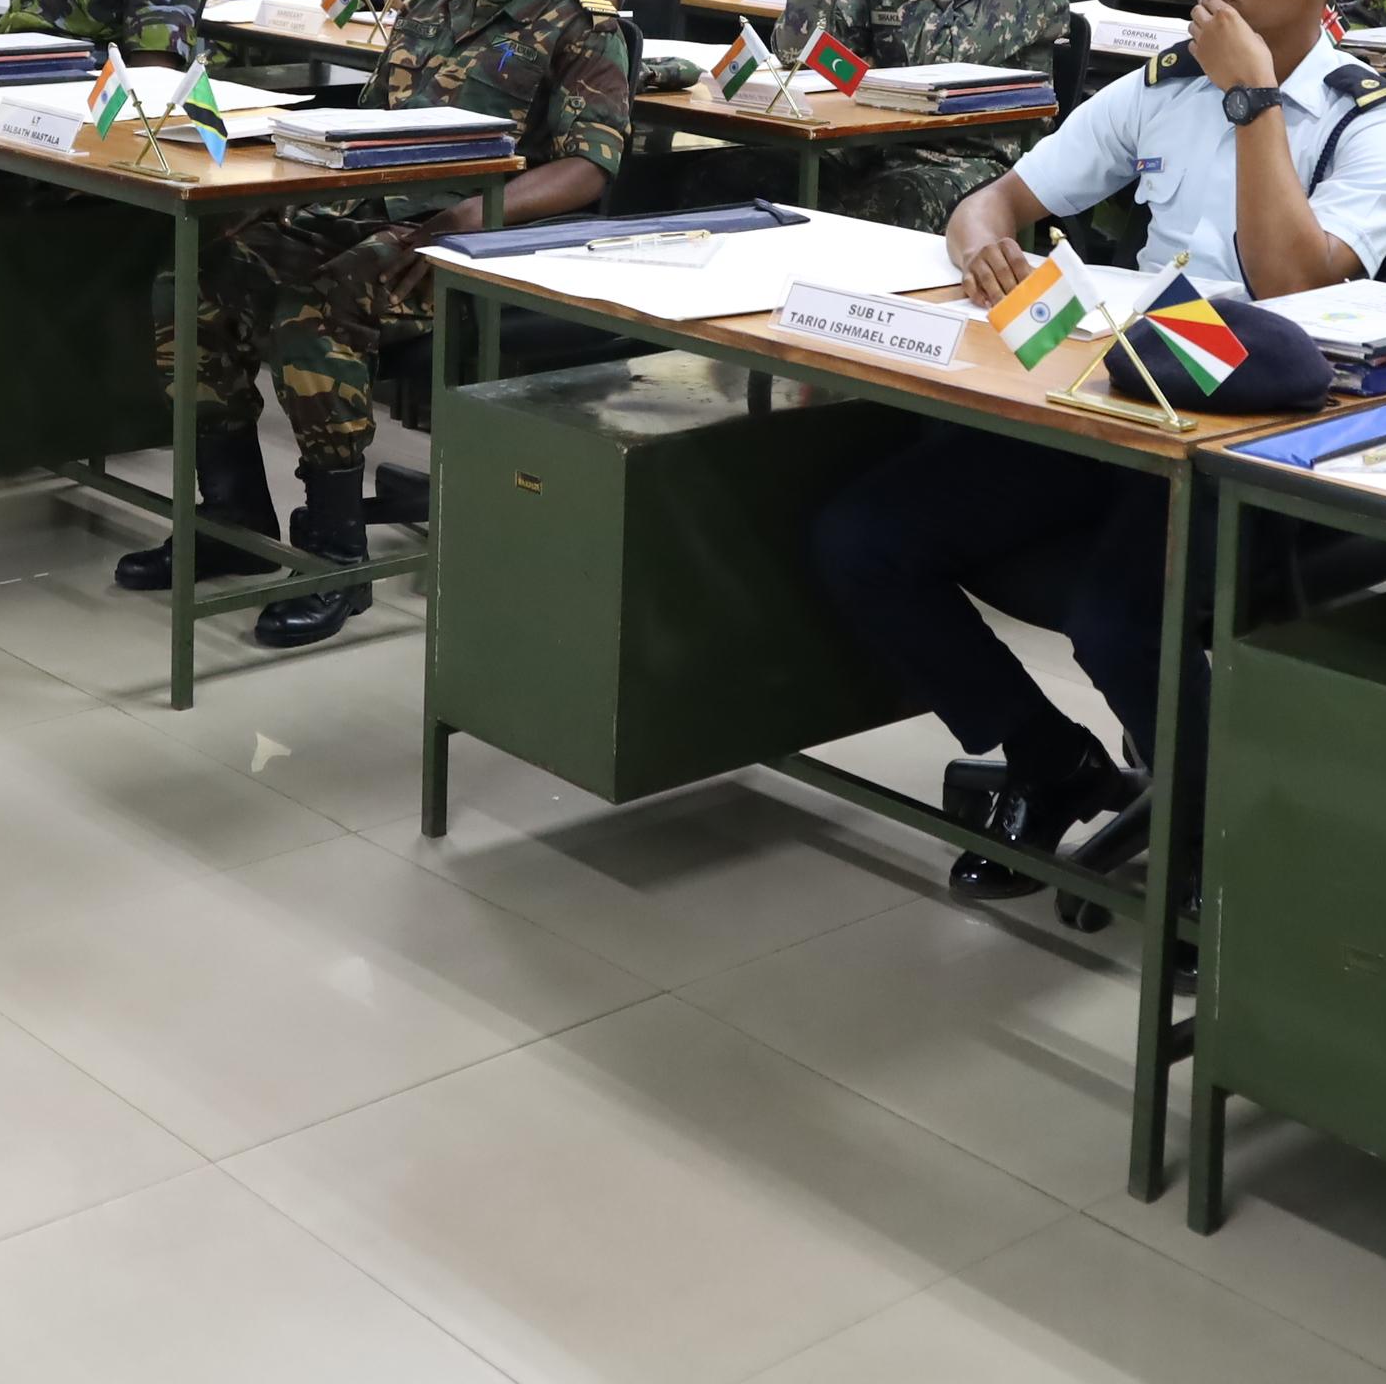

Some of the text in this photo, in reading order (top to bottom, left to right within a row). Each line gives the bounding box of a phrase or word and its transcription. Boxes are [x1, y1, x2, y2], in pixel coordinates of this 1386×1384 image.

[1122, 29, 1157, 40] CORPORAL
[31, 114, 41, 125] LT
[848, 303, 895, 324] SUB LT
[790, 311, 942, 357] TARIQ ISHMAEL CEDRAS
